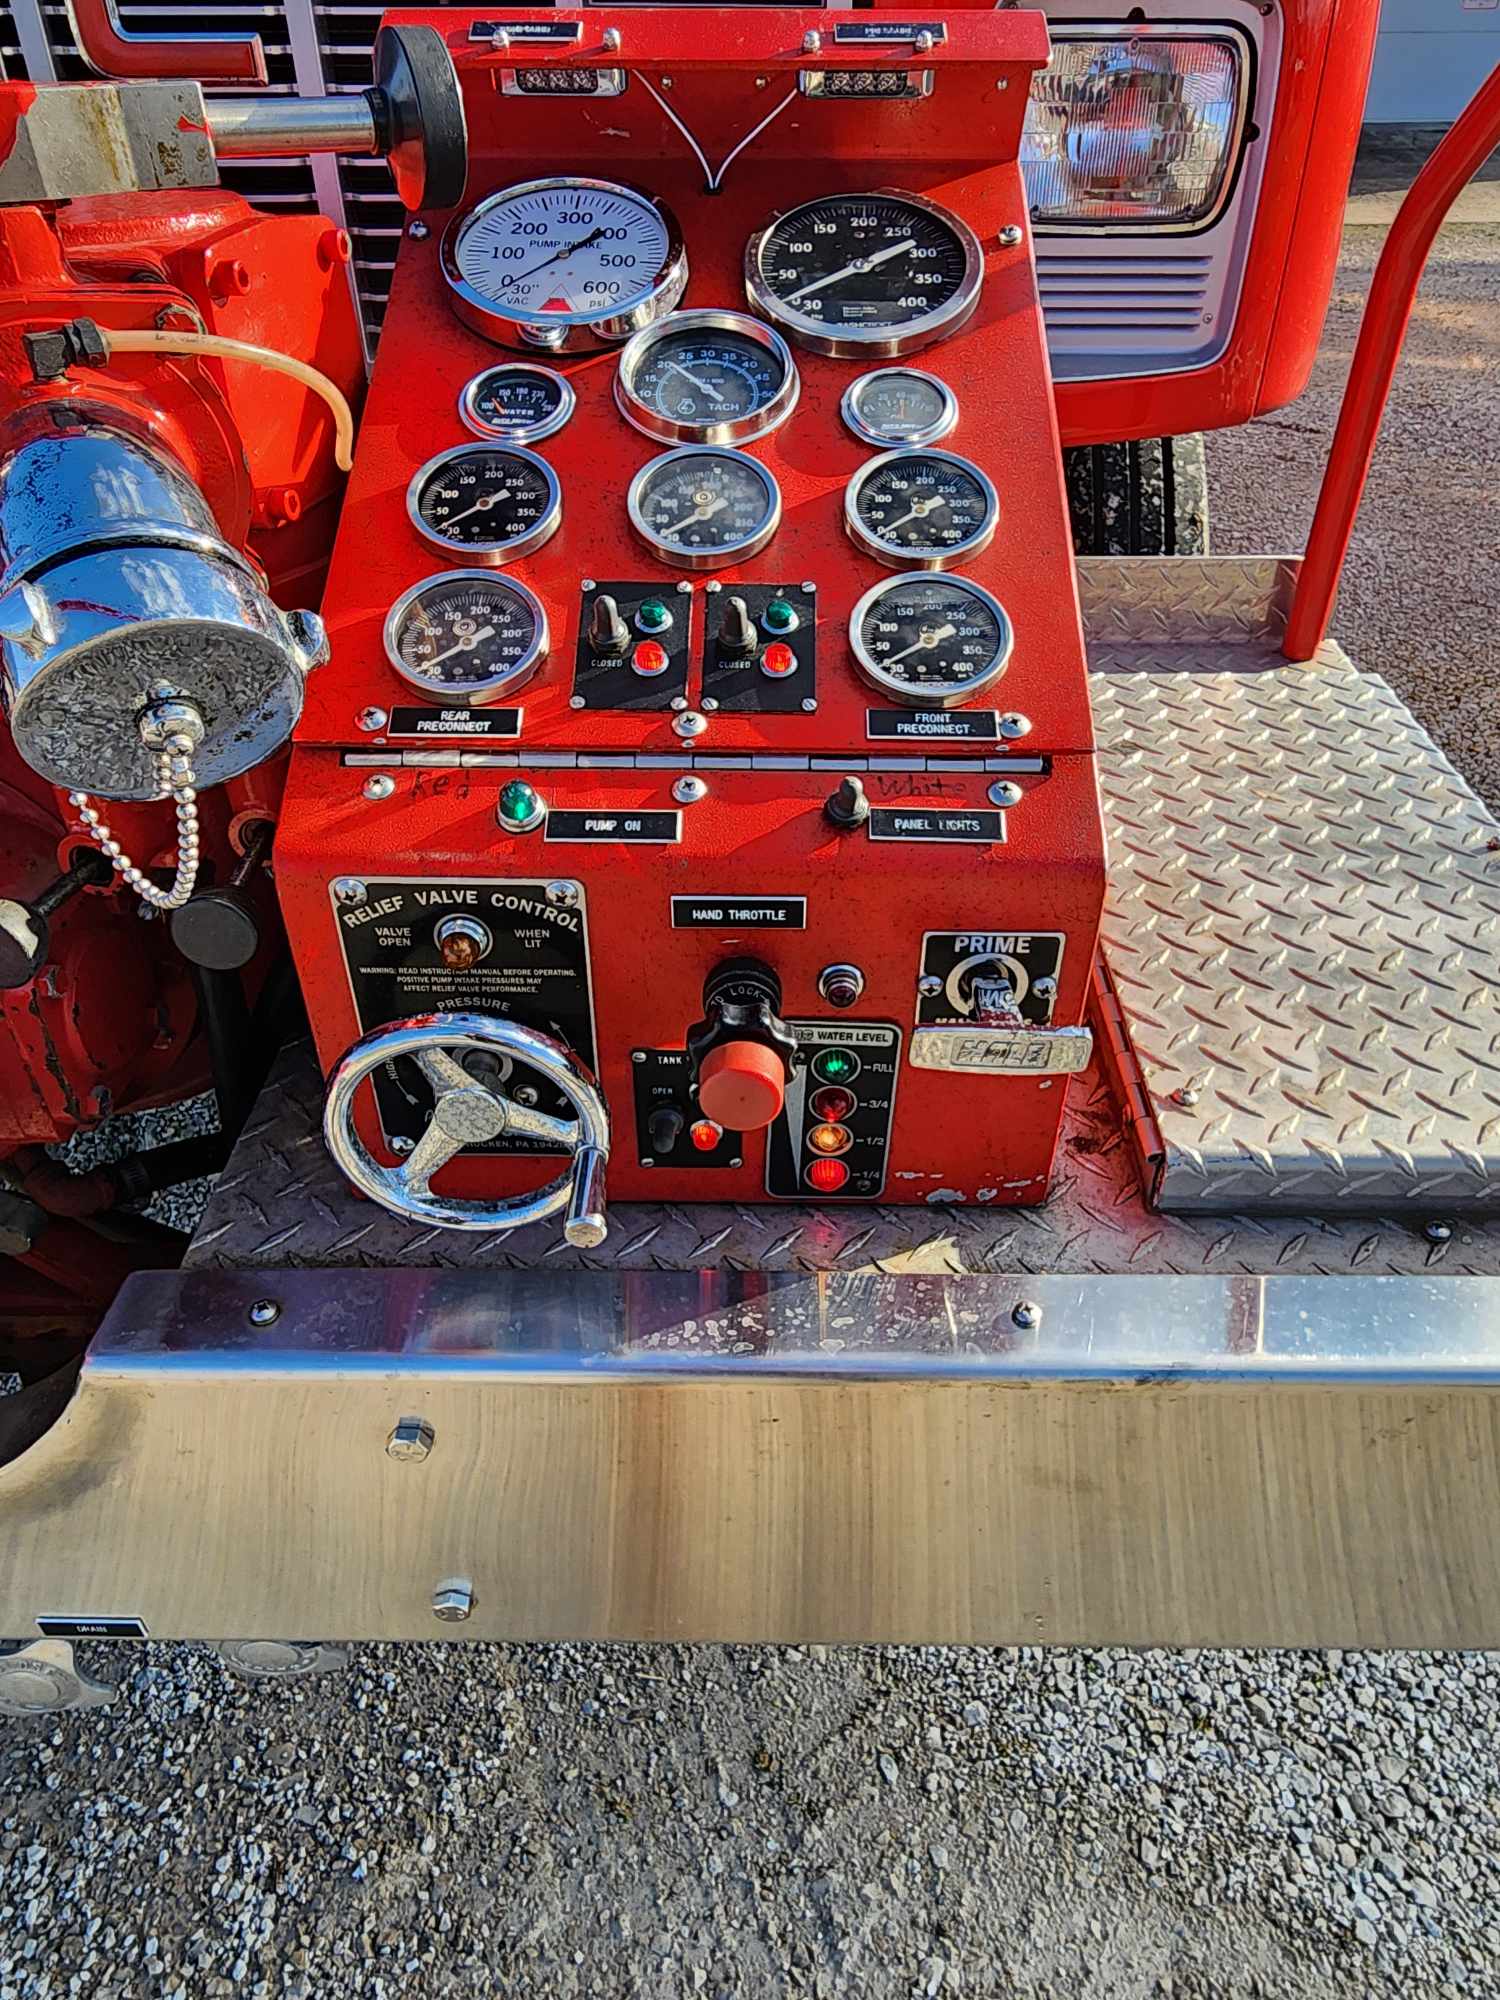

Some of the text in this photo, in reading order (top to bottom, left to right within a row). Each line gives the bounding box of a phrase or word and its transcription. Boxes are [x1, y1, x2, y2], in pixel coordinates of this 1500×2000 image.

[557, 212, 593, 225] 300
[850, 217, 878, 227] 200
[511, 222, 548, 236] 200
[814, 223, 836, 234] 150
[884, 227, 912, 237] 250
[603, 227, 627, 240] 00
[529, 240, 602, 249] PUMP INKE
[789, 242, 813, 253] 100
[491, 246, 525, 260] 100
[909, 248, 937, 258] 300
[600, 254, 636, 268] 500
[778, 269, 797, 280] 50
[914, 274, 942, 284] 350
[501, 275, 513, 287] 0
[583, 281, 620, 294] 600
[506, 297, 529, 305] VAC
[589, 298, 606, 308] psi
[803, 299, 822, 311] 30
[897, 297, 927, 308] 400
[678, 352, 694, 360] 25
[700, 350, 716, 358] 30
[639, 390, 652, 398] 10
[708, 403, 740, 411] TACH
[460, 476, 476, 484] 150
[505, 479, 524, 487] 250
[892, 481, 908, 489] 150
[938, 485, 957, 493] 250
[441, 490, 459, 498] 100
[874, 494, 892, 502] 100
[949, 499, 969, 507] 300
[436, 507, 449, 515] 50
[871, 511, 884, 519] 50
[952, 515, 970, 523] 350
[505, 523, 526, 531] 400
[942, 530, 962, 539] 400
[470, 606, 490, 615] 200
[897, 607, 914, 616] 150
[444, 612, 462, 621] 150
[492, 615, 511, 623] 250
[946, 612, 966, 620] 250
[424, 627, 442, 635] 100
[879, 623, 898, 632] 100
[959, 627, 980, 636] 300
[501, 629, 522, 638] 300
[417, 645, 431, 653] 50
[502, 647, 521, 655] 350
[876, 642, 890, 651] 50
[962, 646, 982, 655] 350
[488, 663, 510, 672] 400
[591, 659, 623, 668] CLOSED
[952, 663, 974, 671] 400
[440, 710, 470, 721] REAR
[915, 713, 952, 724] FRONT
[417, 721, 492, 732] PRECONNECT
[897, 723, 971, 735] PRECONNECT
[584, 819, 641, 832] PUMP ON
[894, 818, 933, 831] PANEL
[342, 890, 580, 933] RELIEF VALVE CONTROL
[692, 909, 787, 922] HAND THROTTLE
[375, 927, 412, 937] VALVE
[514, 929, 551, 939] WHEN
[378, 938, 412, 947] OPEN
[524, 939, 542, 949] LIT
[954, 935, 1032, 954] PRIME
[359, 967, 577, 977] WARNING: READ INSTRUCN MANUAL BEFORE OPERATING.
[431, 976, 452, 984] PUMP
[481, 977, 525, 985] PRESSURES
[458, 985, 480, 993] VALVE
[729, 985, 761, 998] LOCK
[436, 996, 511, 1013] PRESSURE
[817, 1030, 853, 1041] WATER
[855, 1032, 889, 1043] LEVEL
[657, 1055, 682, 1065] TANK
[872, 1063, 894, 1074] FULL
[869, 1100, 889, 1110] 3/4
[515, 1140, 529, 1149] PA
[866, 1136, 885, 1146] 1/2
[862, 1169, 880, 1179] 1/4
